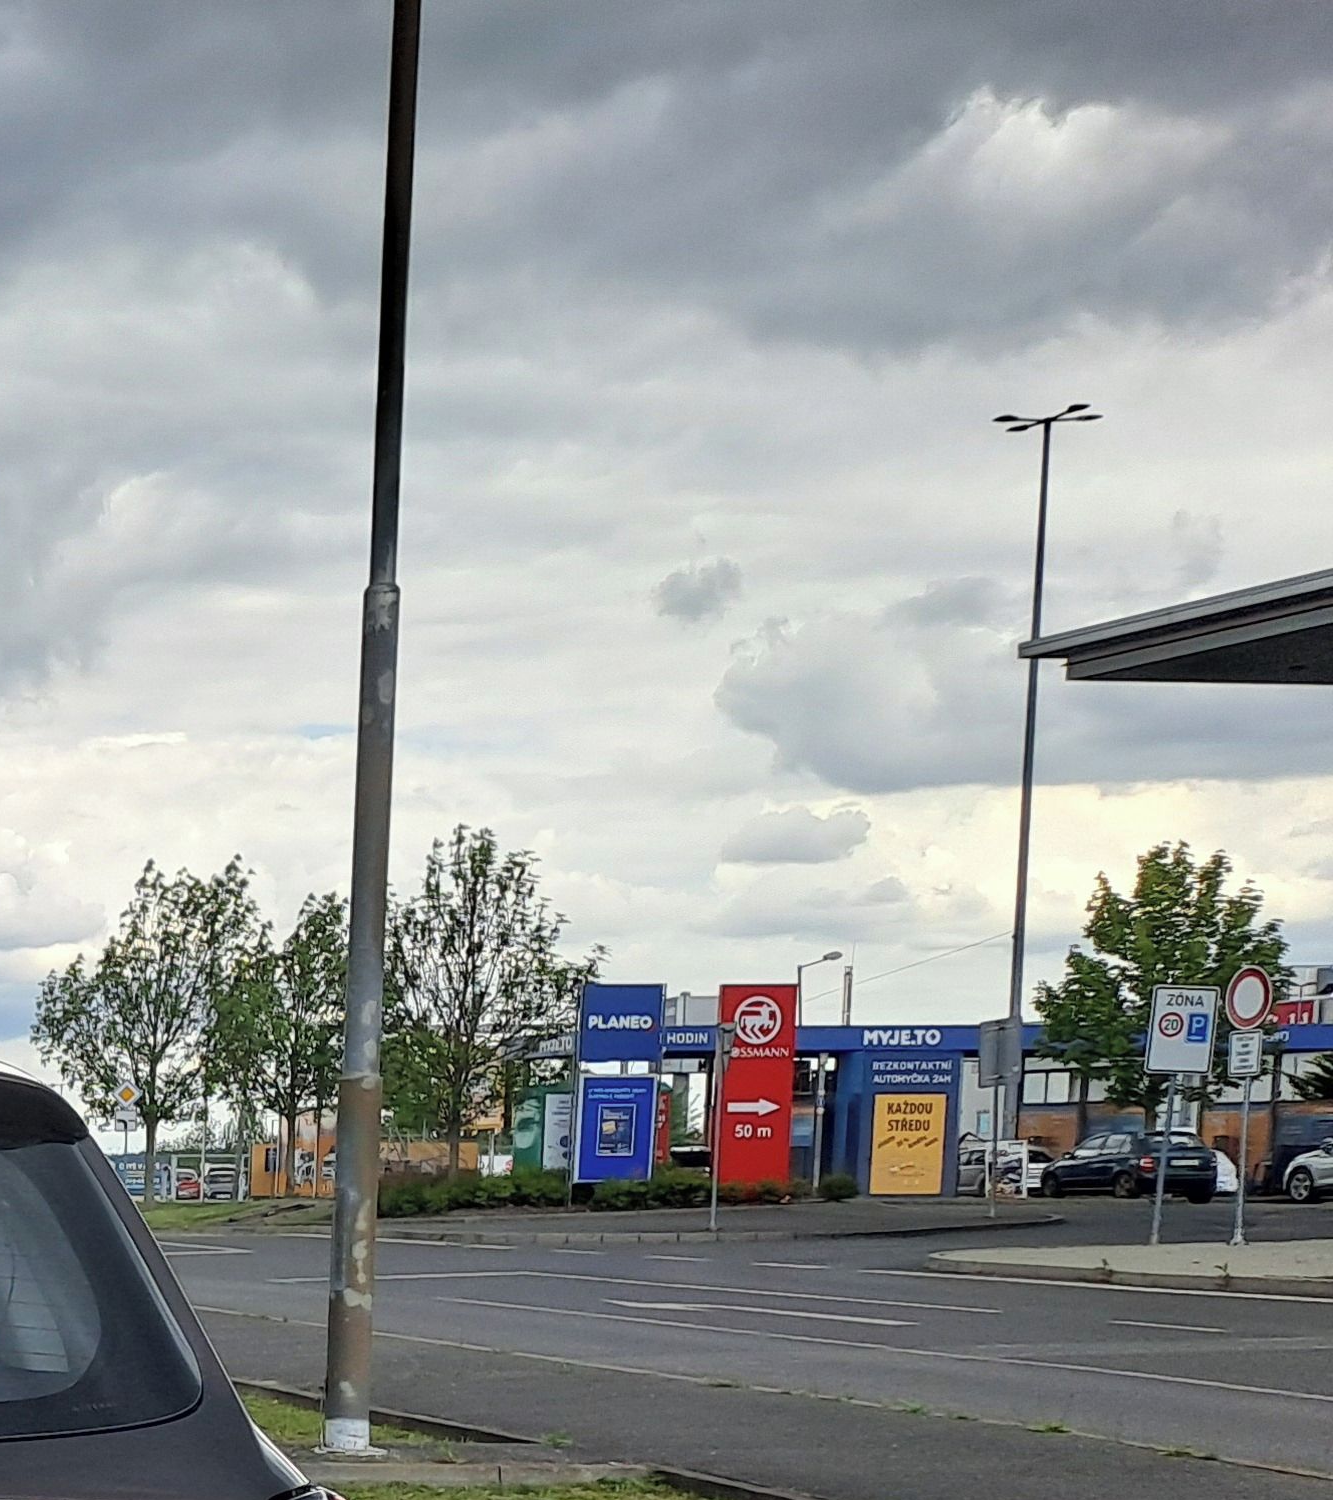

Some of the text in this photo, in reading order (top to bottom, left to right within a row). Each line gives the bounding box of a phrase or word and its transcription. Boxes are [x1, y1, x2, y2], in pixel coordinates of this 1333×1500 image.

[1166, 992, 1205, 1007] ZÓNA
[588, 1014, 653, 1030] PLANEO
[1164, 1018, 1179, 1031] 20
[1191, 1016, 1205, 1034] P
[666, 1031, 709, 1045] HODIN
[862, 1029, 942, 1046] MYJE.TO
[872, 1060, 953, 1071] BEZKONTAKTNÍ
[887, 1100, 934, 1115] KAŽDOU
[734, 1124, 772, 1138] 50 m
[887, 1118, 931, 1132] STŘEDU
